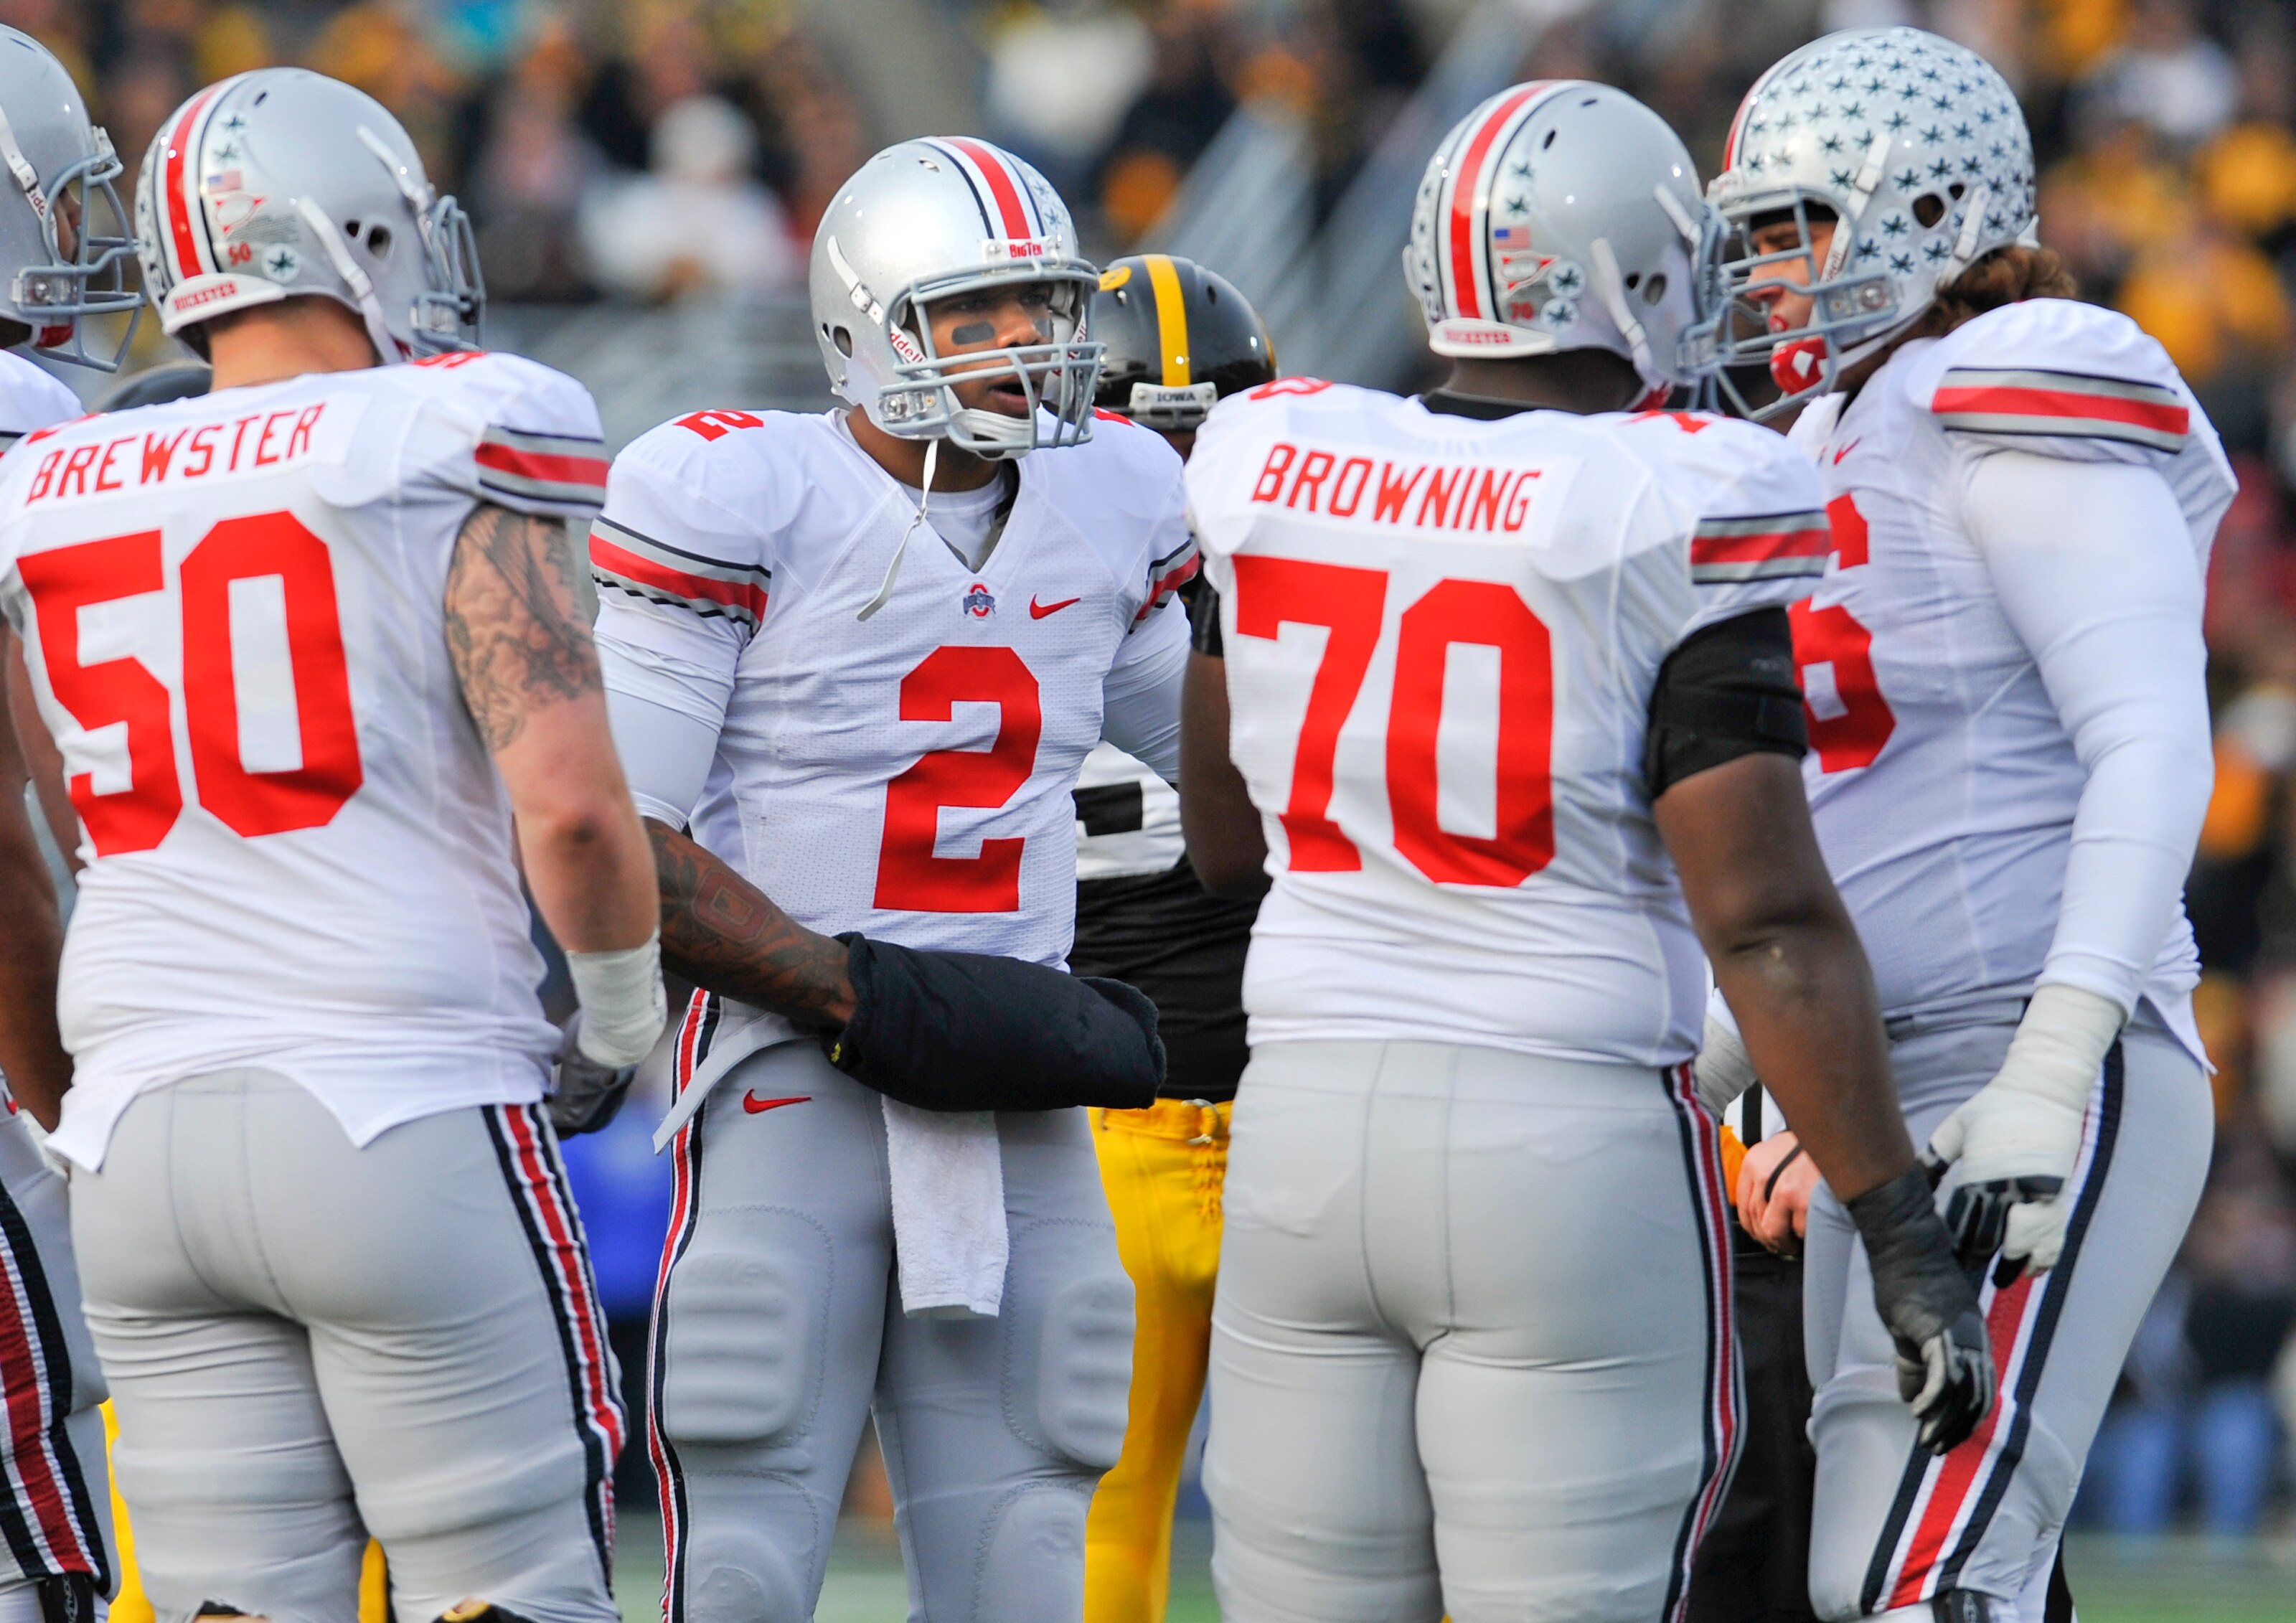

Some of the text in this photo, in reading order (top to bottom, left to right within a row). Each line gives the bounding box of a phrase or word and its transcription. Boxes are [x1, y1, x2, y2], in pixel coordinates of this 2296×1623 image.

[672, 408, 764, 442] 2
[1157, 391, 1197, 402] IOWA
[26, 402, 325, 505] BREWSTER
[1251, 442, 1540, 532] BROWNING
[16, 509, 364, 858] 50
[1231, 553, 1556, 888] 70
[873, 645, 1043, 913] 2
